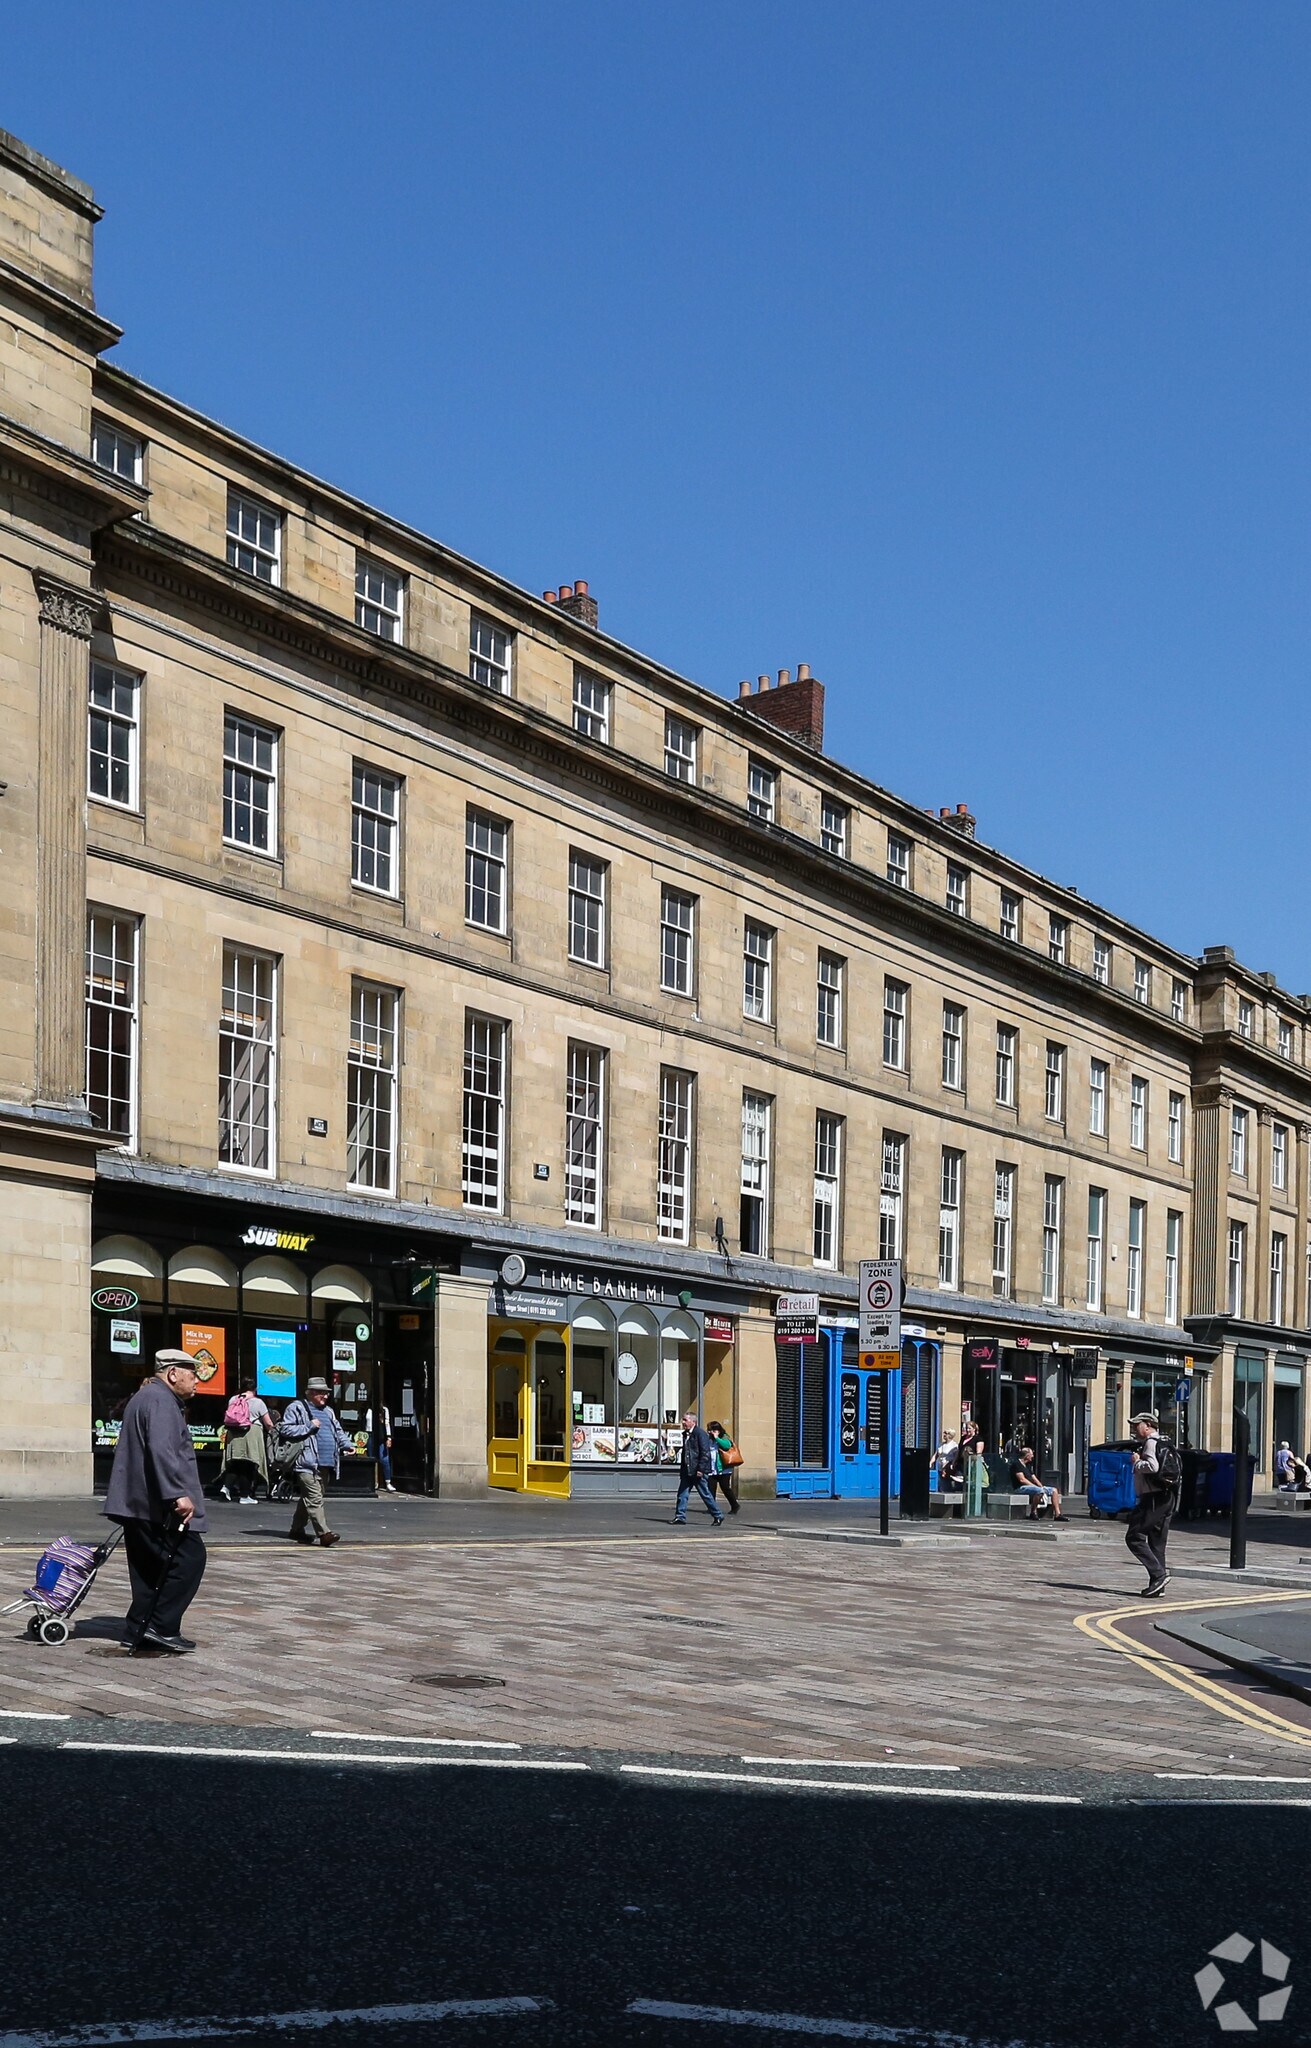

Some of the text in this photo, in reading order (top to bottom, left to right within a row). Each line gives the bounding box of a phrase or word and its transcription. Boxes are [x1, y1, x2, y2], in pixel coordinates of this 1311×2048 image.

[239, 1225, 315, 1252] SUBWAY
[868, 1269, 893, 1277] ZONE
[540, 1268, 664, 1302] TIME BANH MI
[97, 1291, 132, 1307] OPEN
[972, 1346, 994, 1360] sally
